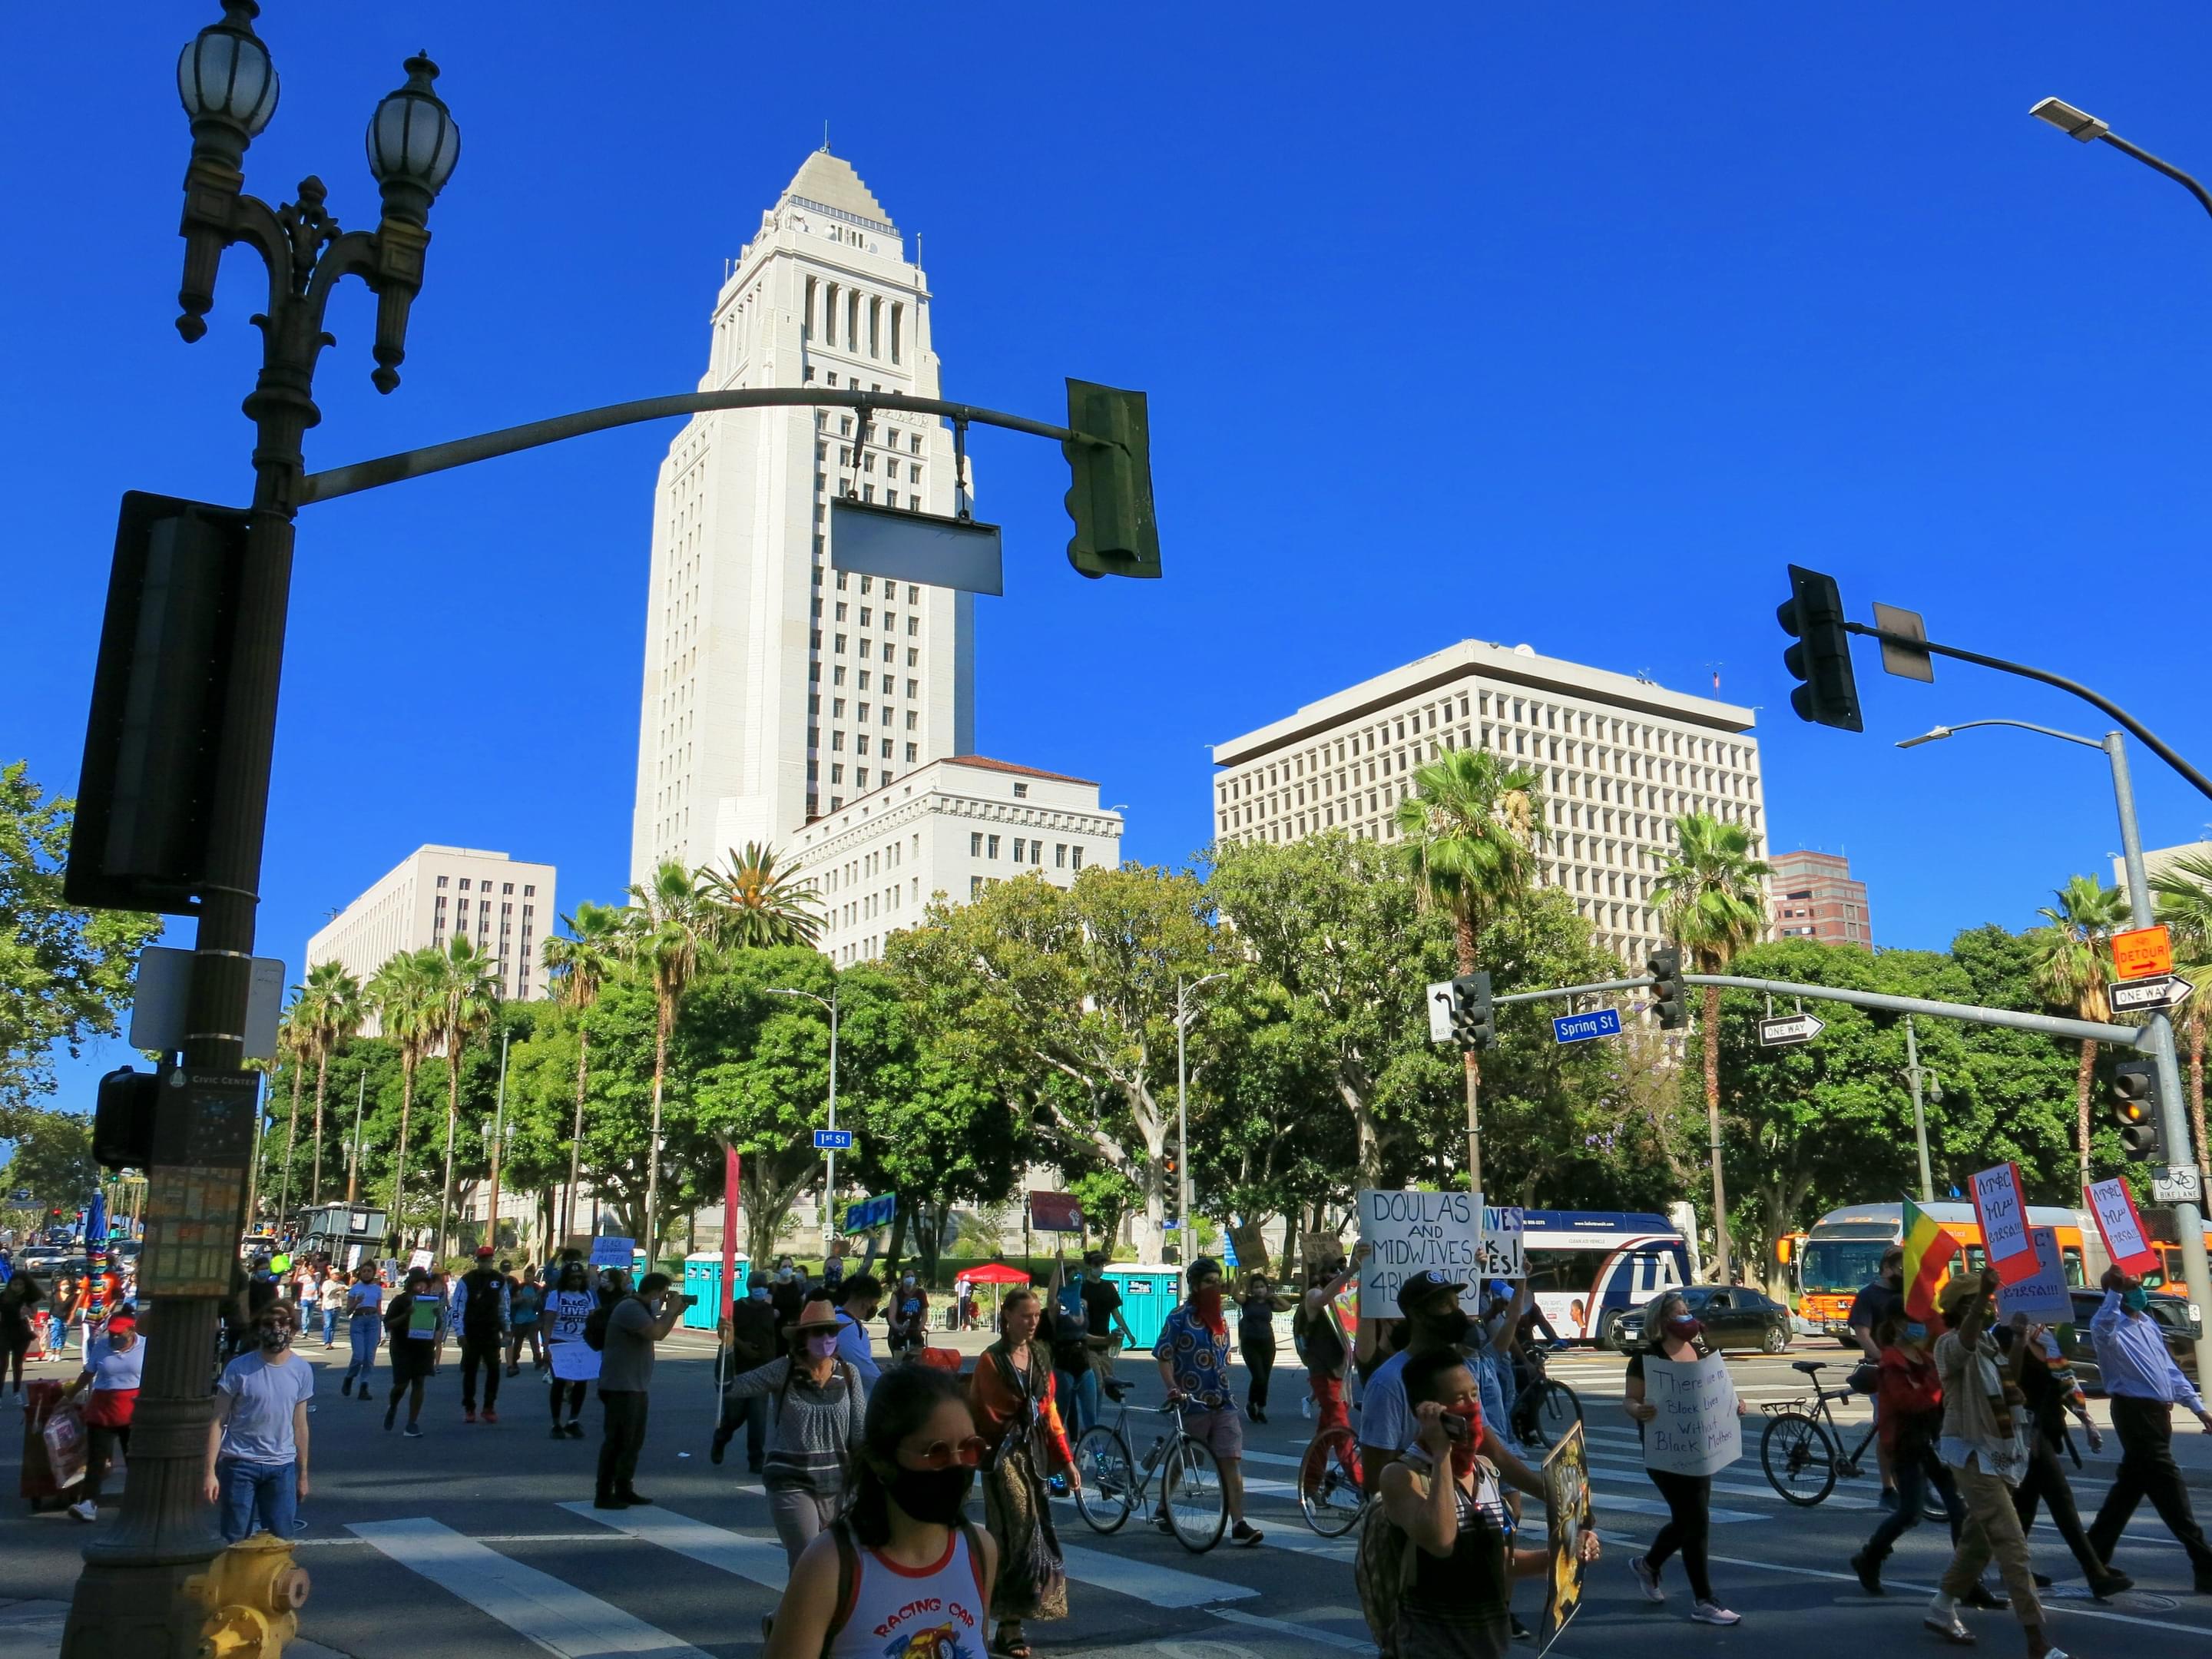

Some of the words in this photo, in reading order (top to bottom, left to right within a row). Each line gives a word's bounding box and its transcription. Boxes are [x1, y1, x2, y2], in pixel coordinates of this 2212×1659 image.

[2120, 945, 2164, 963] DETOUR
[2120, 989, 2142, 1003] ONE
[2145, 985, 2167, 999] WAY
[1560, 1020, 1598, 1037] Spring
[1600, 1015, 1614, 1029] St
[1767, 1026, 1786, 1037] ONE
[1787, 1023, 1806, 1034] WAY
[192, 1075, 218, 1084] CIVIC
[820, 1134, 833, 1144] 1st
[835, 1134, 846, 1144] St
[1373, 1194, 1470, 1224] DOULAS
[1408, 1225, 1443, 1238] AND
[1373, 1240, 1472, 1265] MIDWIVES
[561, 1307, 590, 1316] LIVES
[1653, 1369, 1703, 1395] There
[1665, 1399, 1699, 1415] Black
[1703, 1396, 1719, 1410] Lives
[1677, 1415, 1718, 1435] Without
[1654, 1430, 1701, 1453] Black
[873, 1598, 942, 1637] RACING
[948, 1602, 975, 1629] CAR
